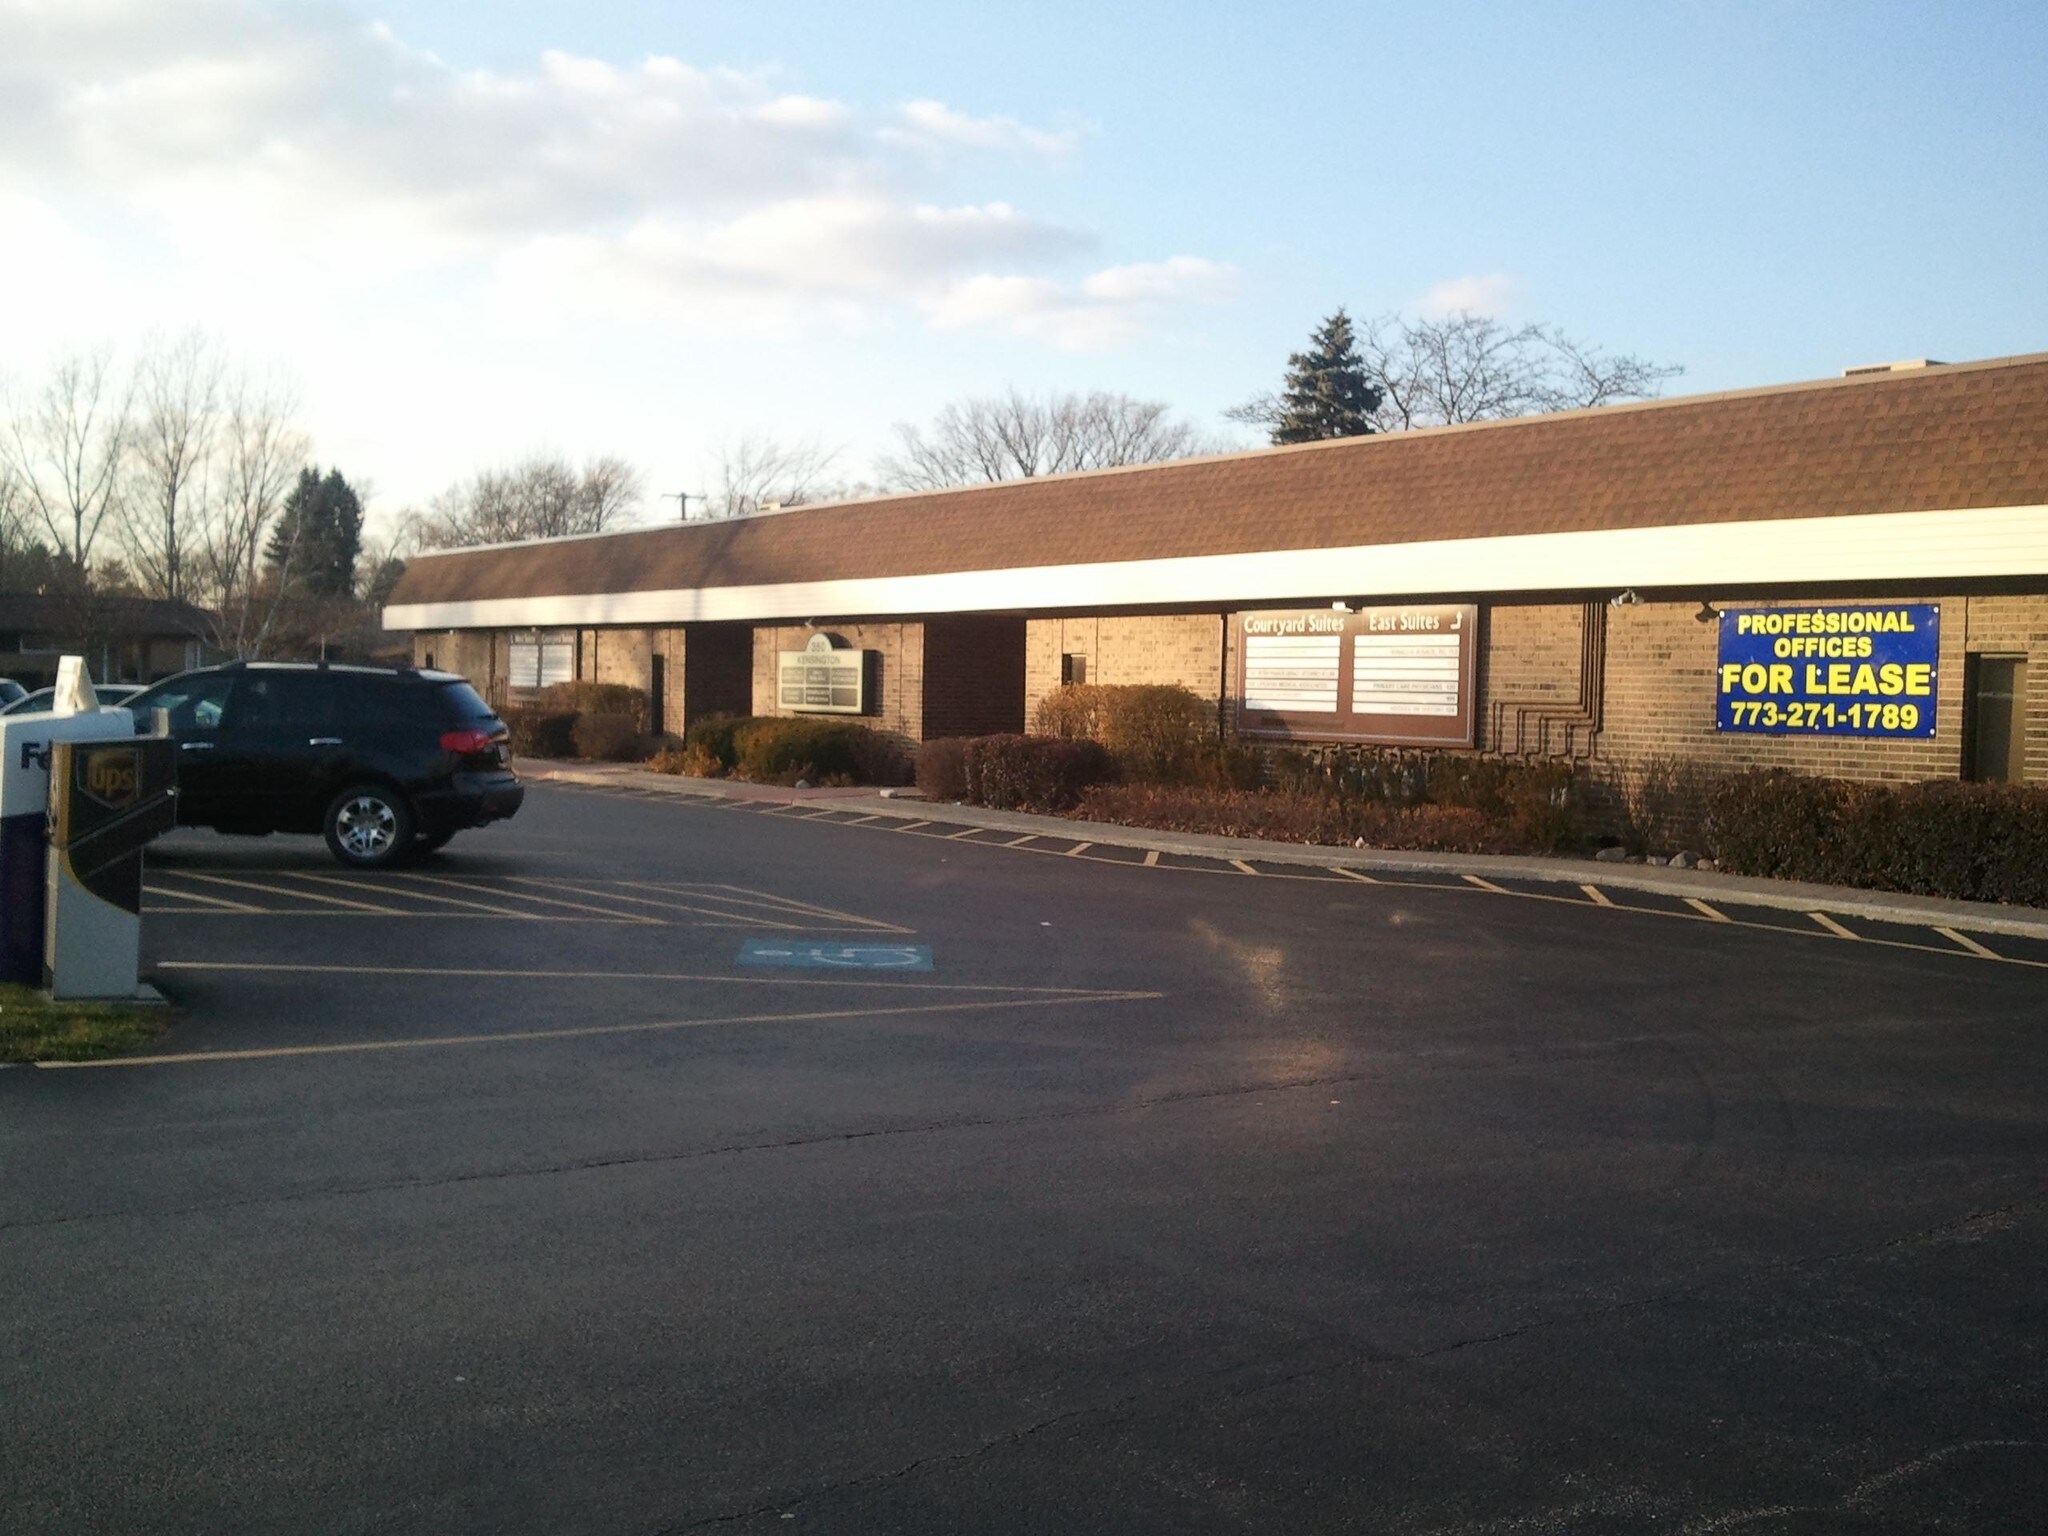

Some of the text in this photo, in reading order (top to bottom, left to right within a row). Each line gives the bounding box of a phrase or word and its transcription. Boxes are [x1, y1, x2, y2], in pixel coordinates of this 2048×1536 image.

[1244, 614, 1345, 636] Courtyard Suites
[1369, 612, 1440, 631] East Suites
[1737, 611, 1915, 635] PROFESSIONAL
[1773, 637, 1873, 658] OFFICES
[1721, 663, 1931, 696] FOR LEASE
[1730, 701, 1920, 730] 773-271-1789
